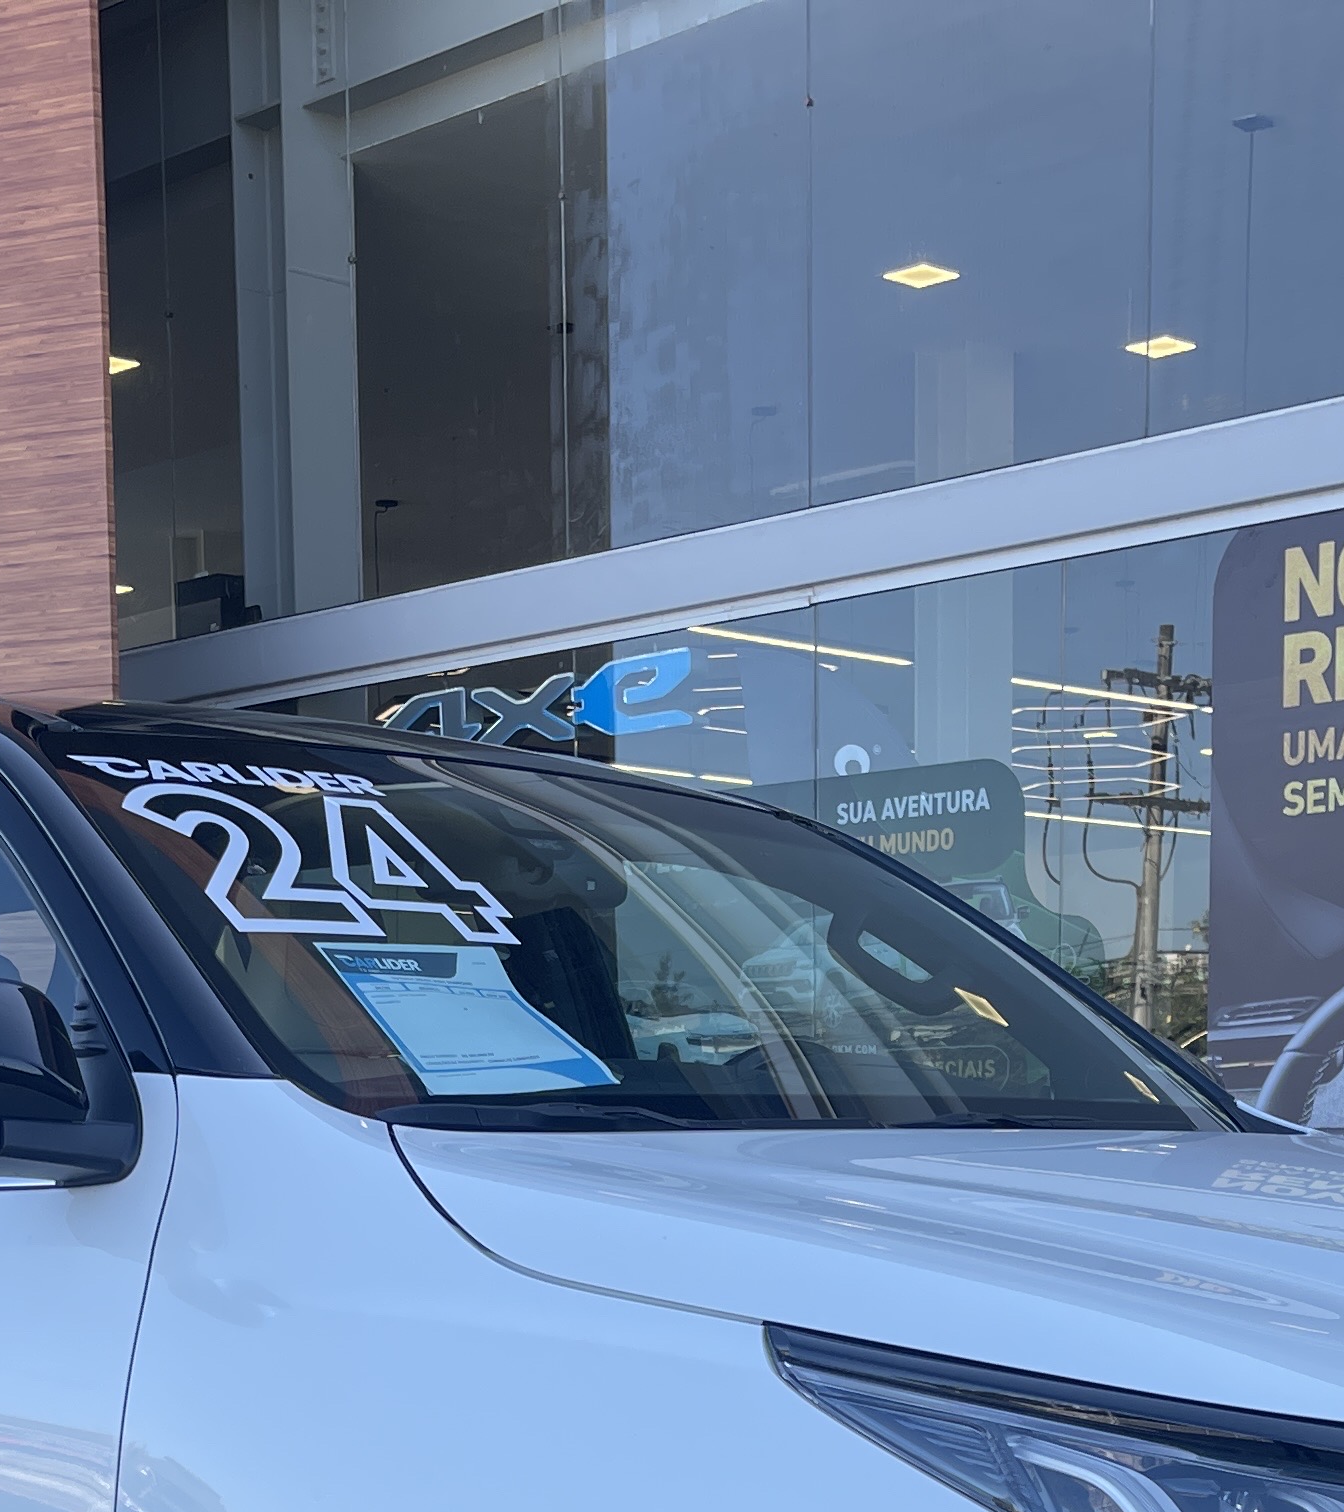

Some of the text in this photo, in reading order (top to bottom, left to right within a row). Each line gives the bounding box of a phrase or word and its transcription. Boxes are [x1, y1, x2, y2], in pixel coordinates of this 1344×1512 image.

[67, 755, 387, 796] CARLIDER
[836, 787, 991, 825] SUA AVENTURA
[880, 828, 954, 855] MUNDO
[122, 783, 521, 944] 24
[334, 954, 422, 972] CARLIDER
